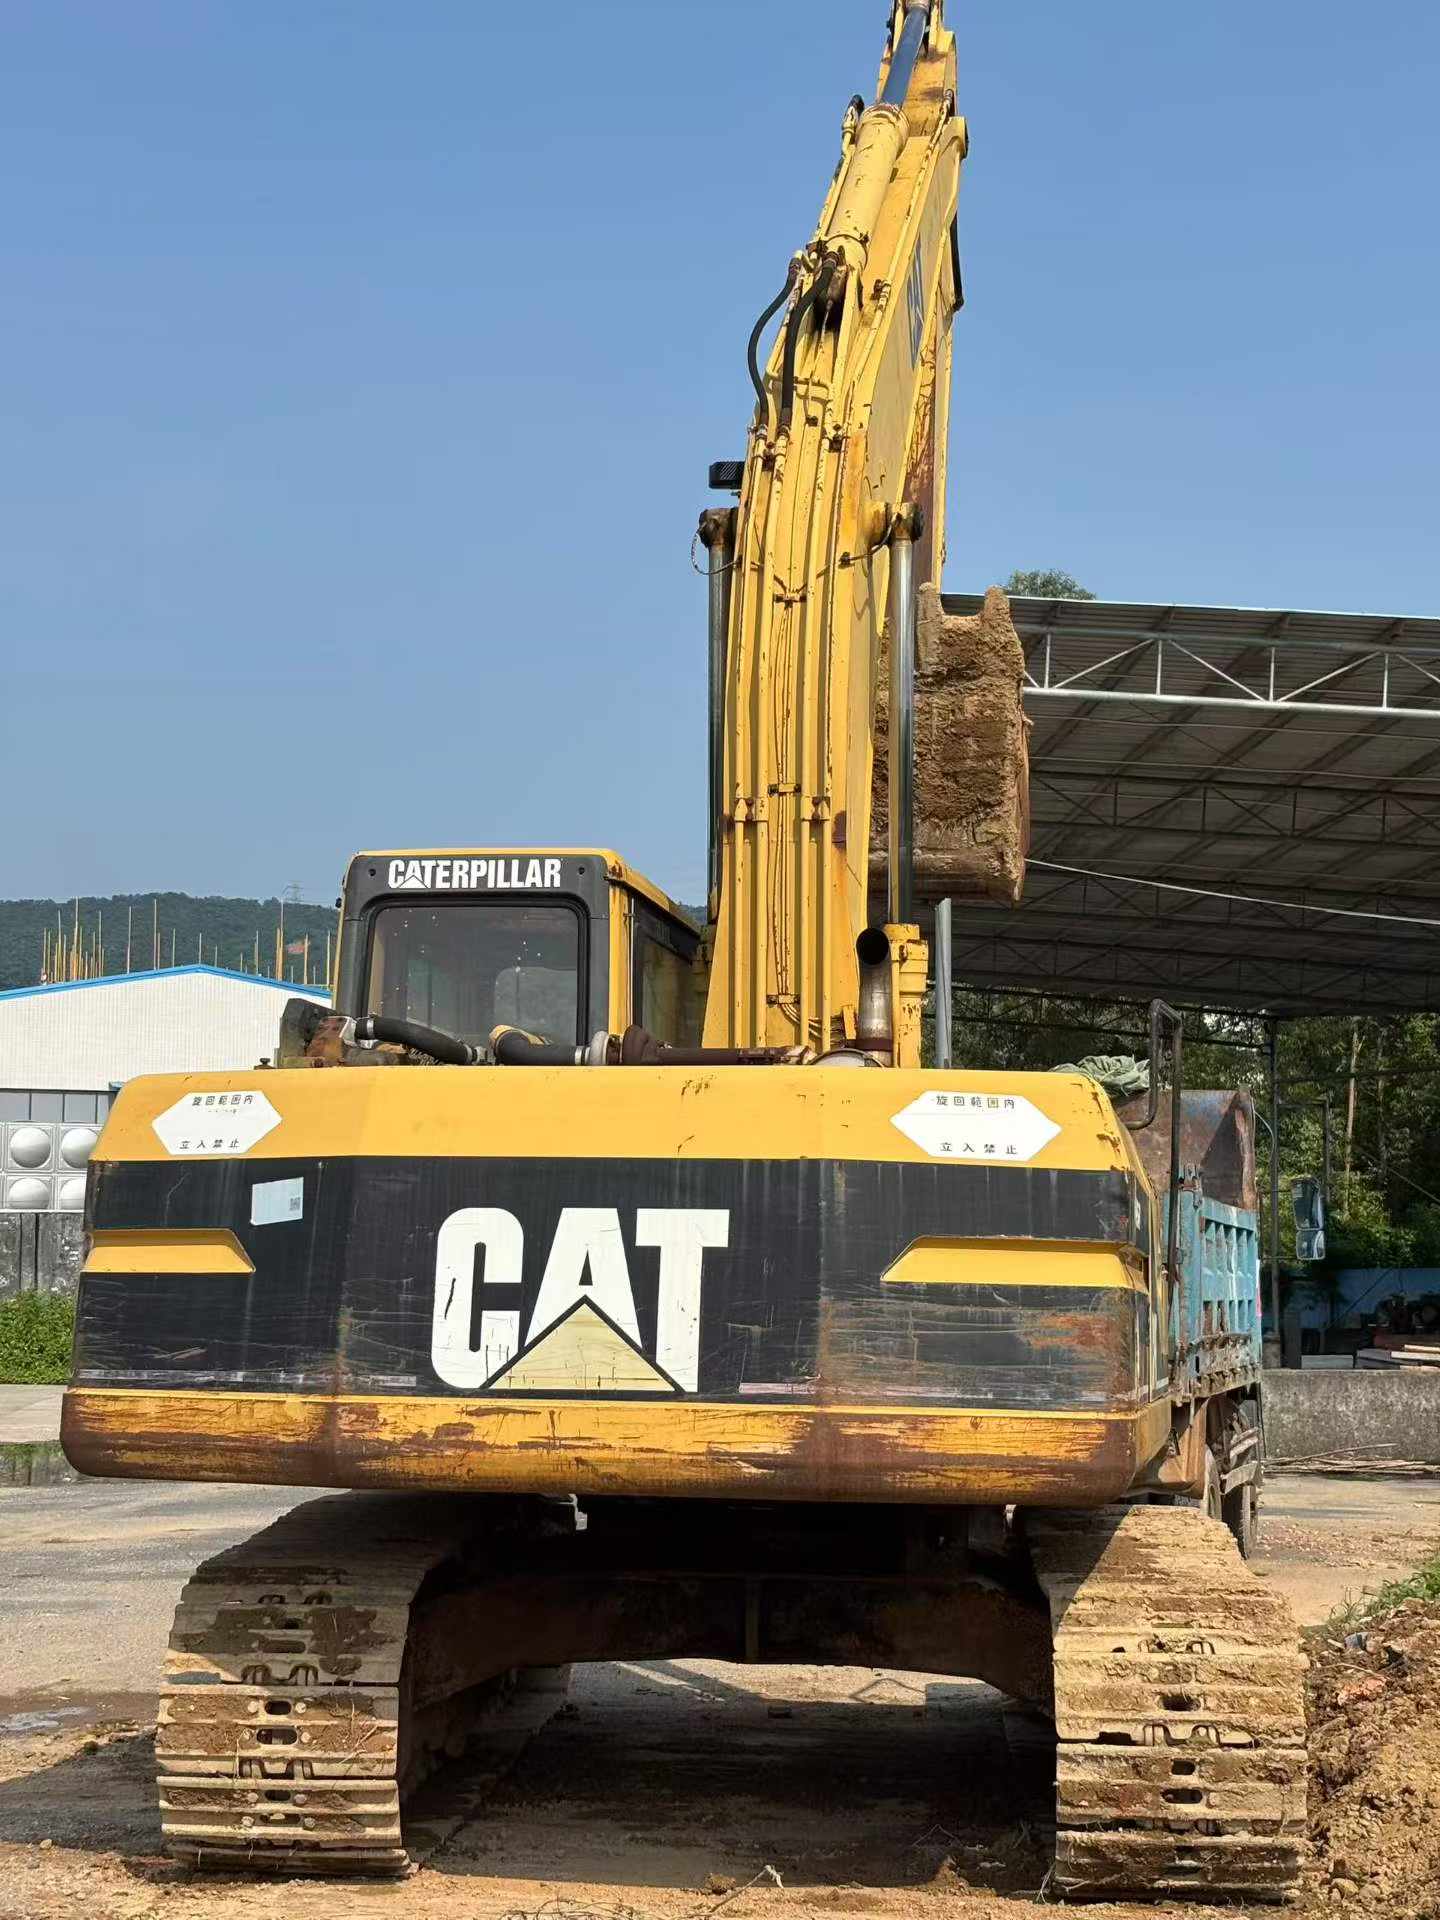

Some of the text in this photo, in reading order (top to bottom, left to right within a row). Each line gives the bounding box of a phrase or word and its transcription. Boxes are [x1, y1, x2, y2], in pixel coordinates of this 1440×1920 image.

[388, 858, 562, 889] CATERPILLAR
[179, 1138, 240, 1150] 立入禁止
[940, 1142, 1017, 1155] 立入禁止
[431, 1207, 730, 1393] CAT
